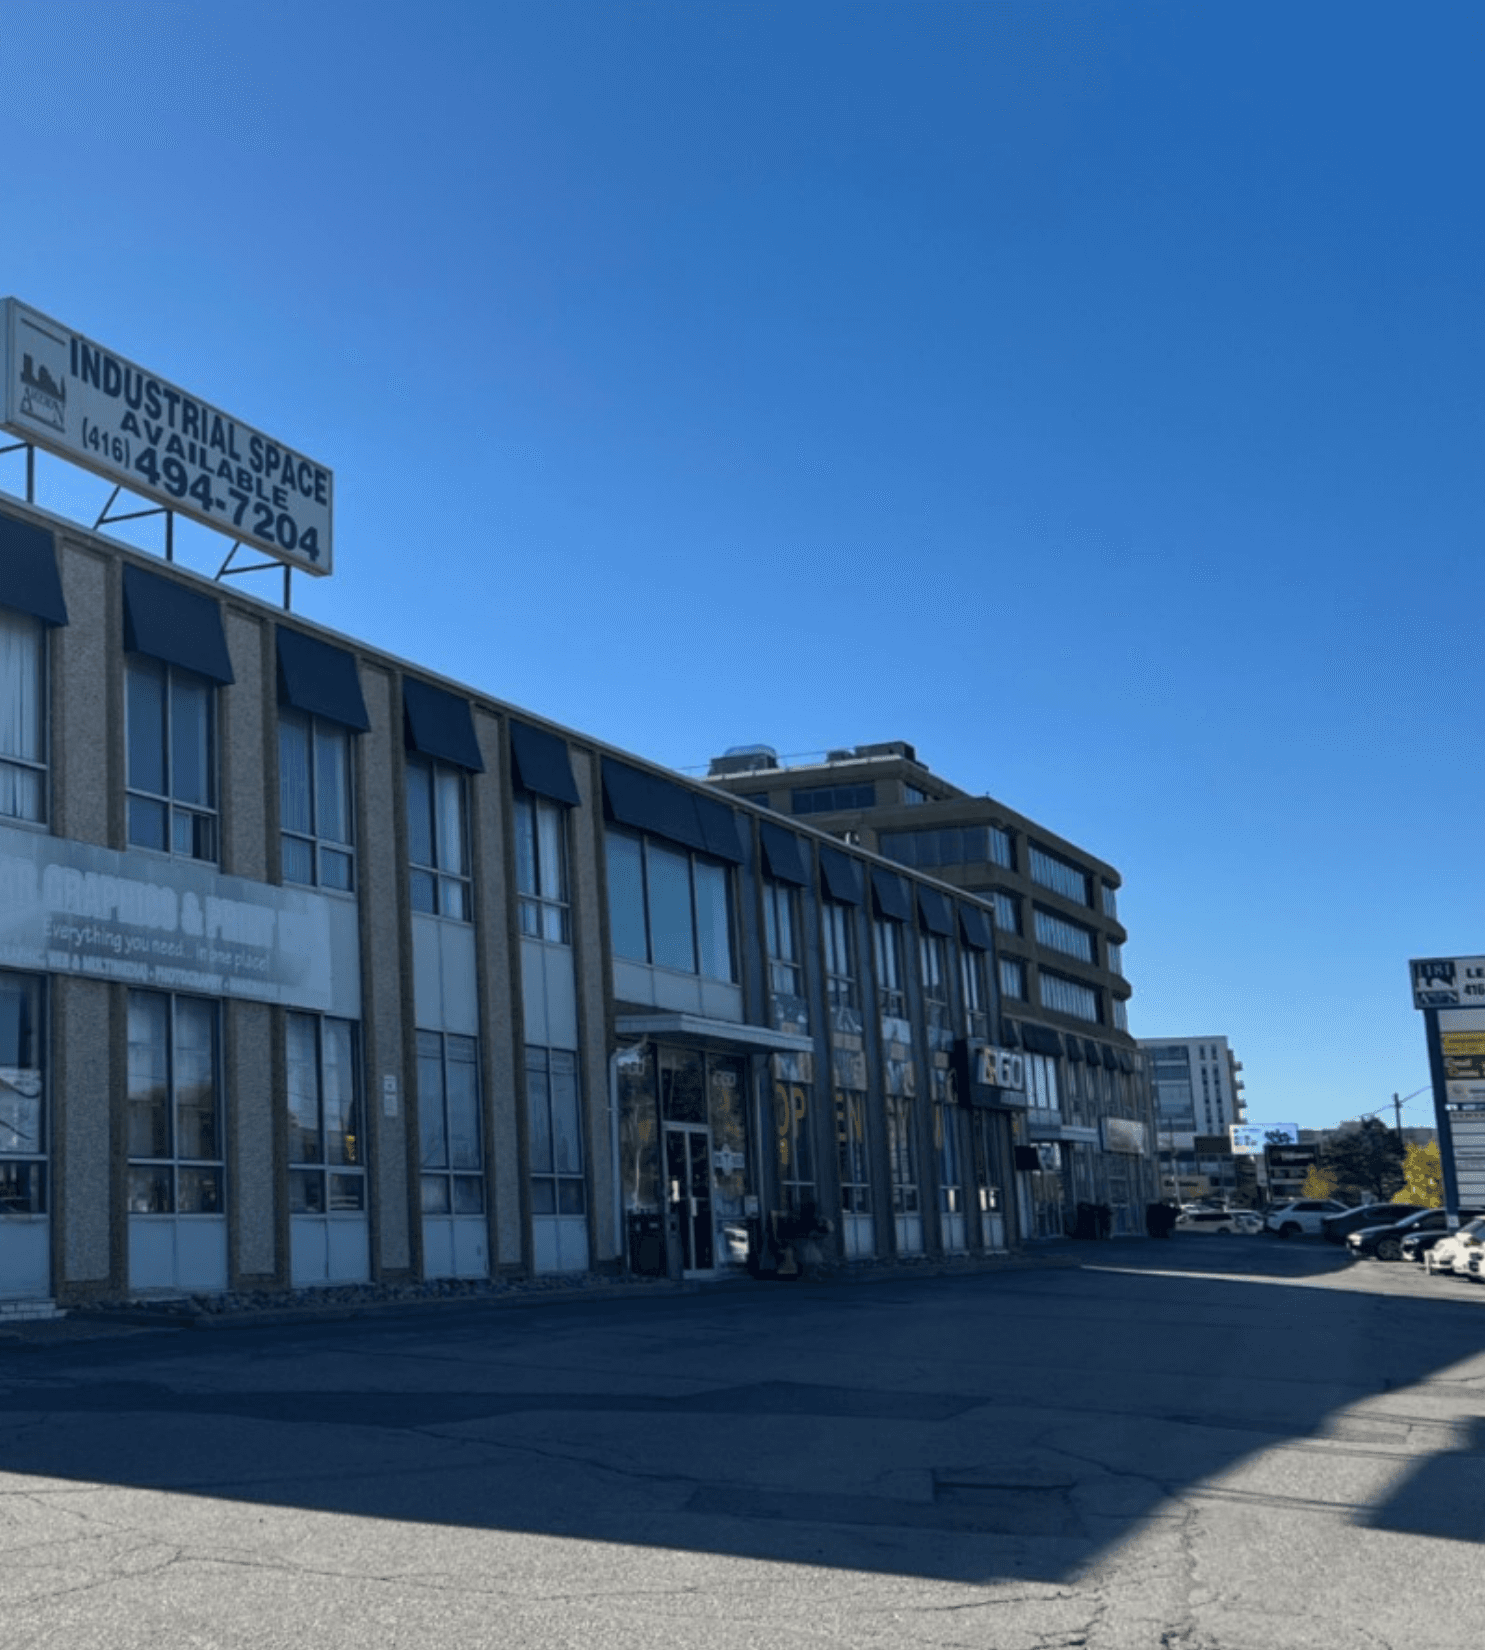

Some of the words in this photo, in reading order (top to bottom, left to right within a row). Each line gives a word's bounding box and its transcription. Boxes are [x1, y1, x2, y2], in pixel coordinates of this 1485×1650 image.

[70, 336, 241, 464] INDUSTRIAL
[248, 434, 328, 507] SPACE
[120, 412, 289, 512] AVAILABLE
[82, 417, 131, 470] (416)
[135, 448, 320, 562] 494-7204
[43, 863, 177, 932] GRAPHICS
[43, 916, 122, 955] Everything
[124, 934, 150, 955] you
